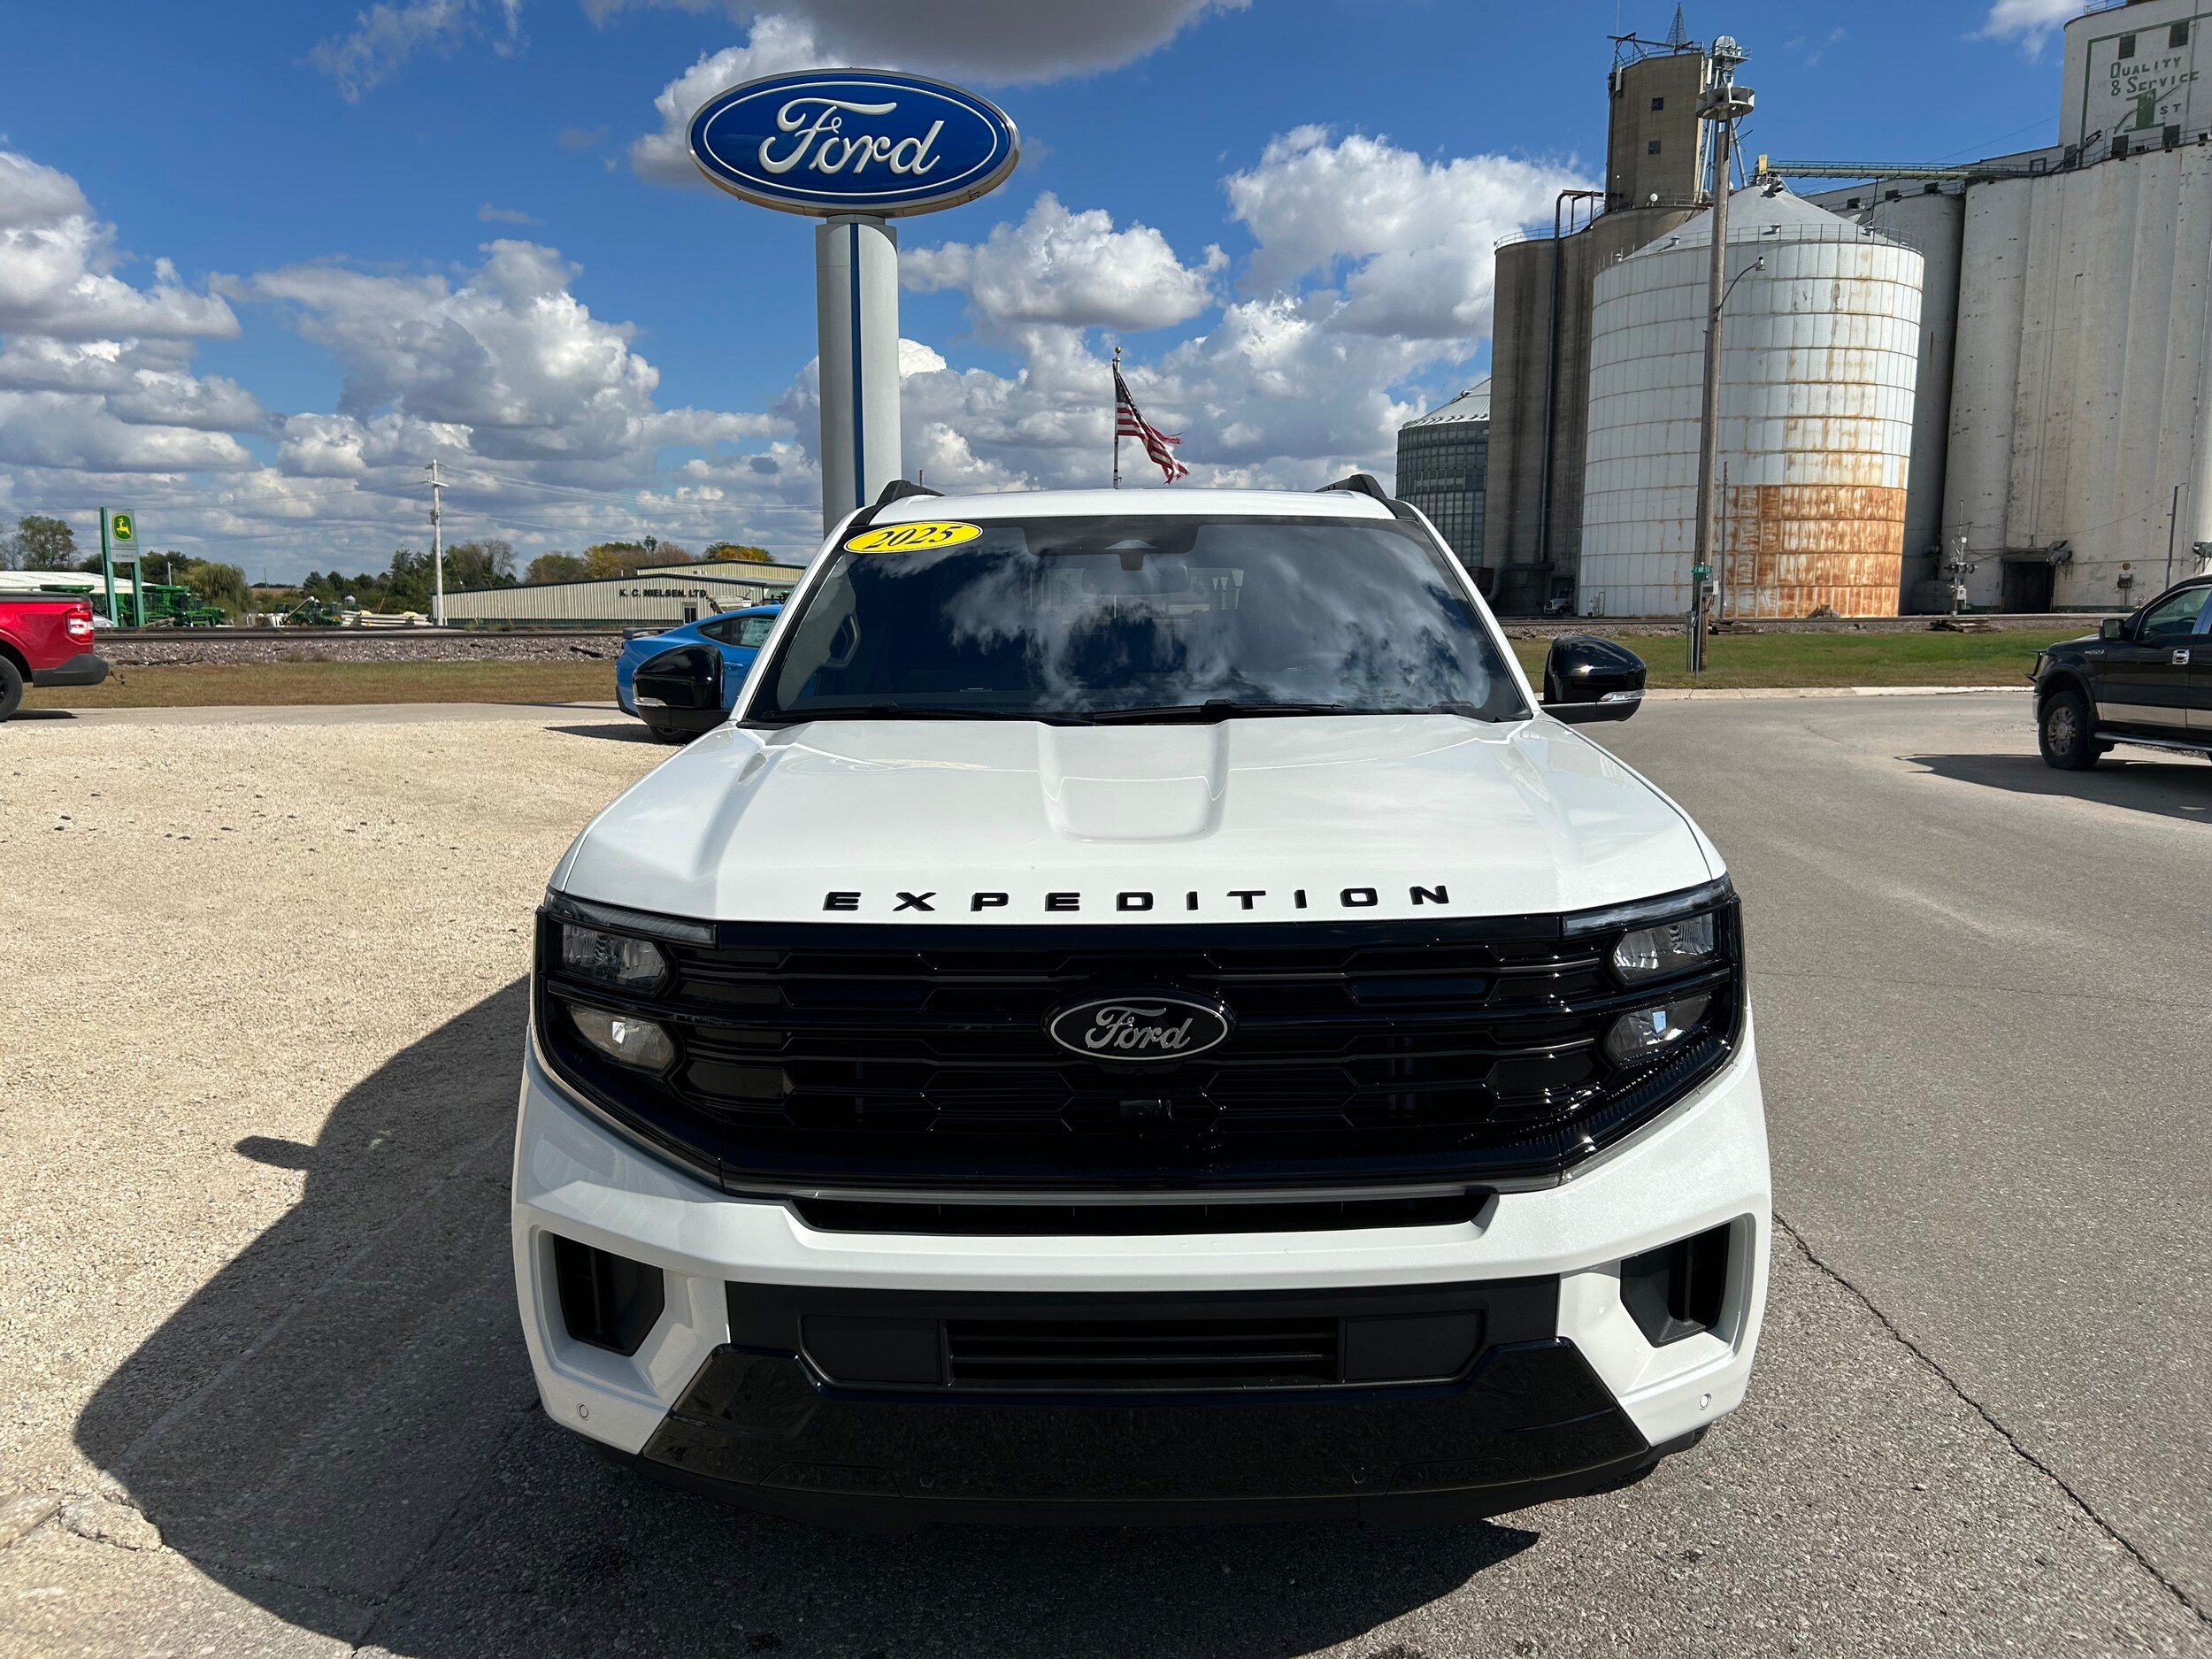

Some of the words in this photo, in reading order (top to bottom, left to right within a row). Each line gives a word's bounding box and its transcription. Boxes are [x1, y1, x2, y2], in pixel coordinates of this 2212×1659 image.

[2110, 57, 2181, 79] QUALITY
[2111, 80, 2121, 96] &
[758, 97, 945, 175] Ford
[862, 526, 964, 549] 2025
[822, 885, 1451, 912] EXPEDITION
[1085, 1006, 1194, 1048] Ford
